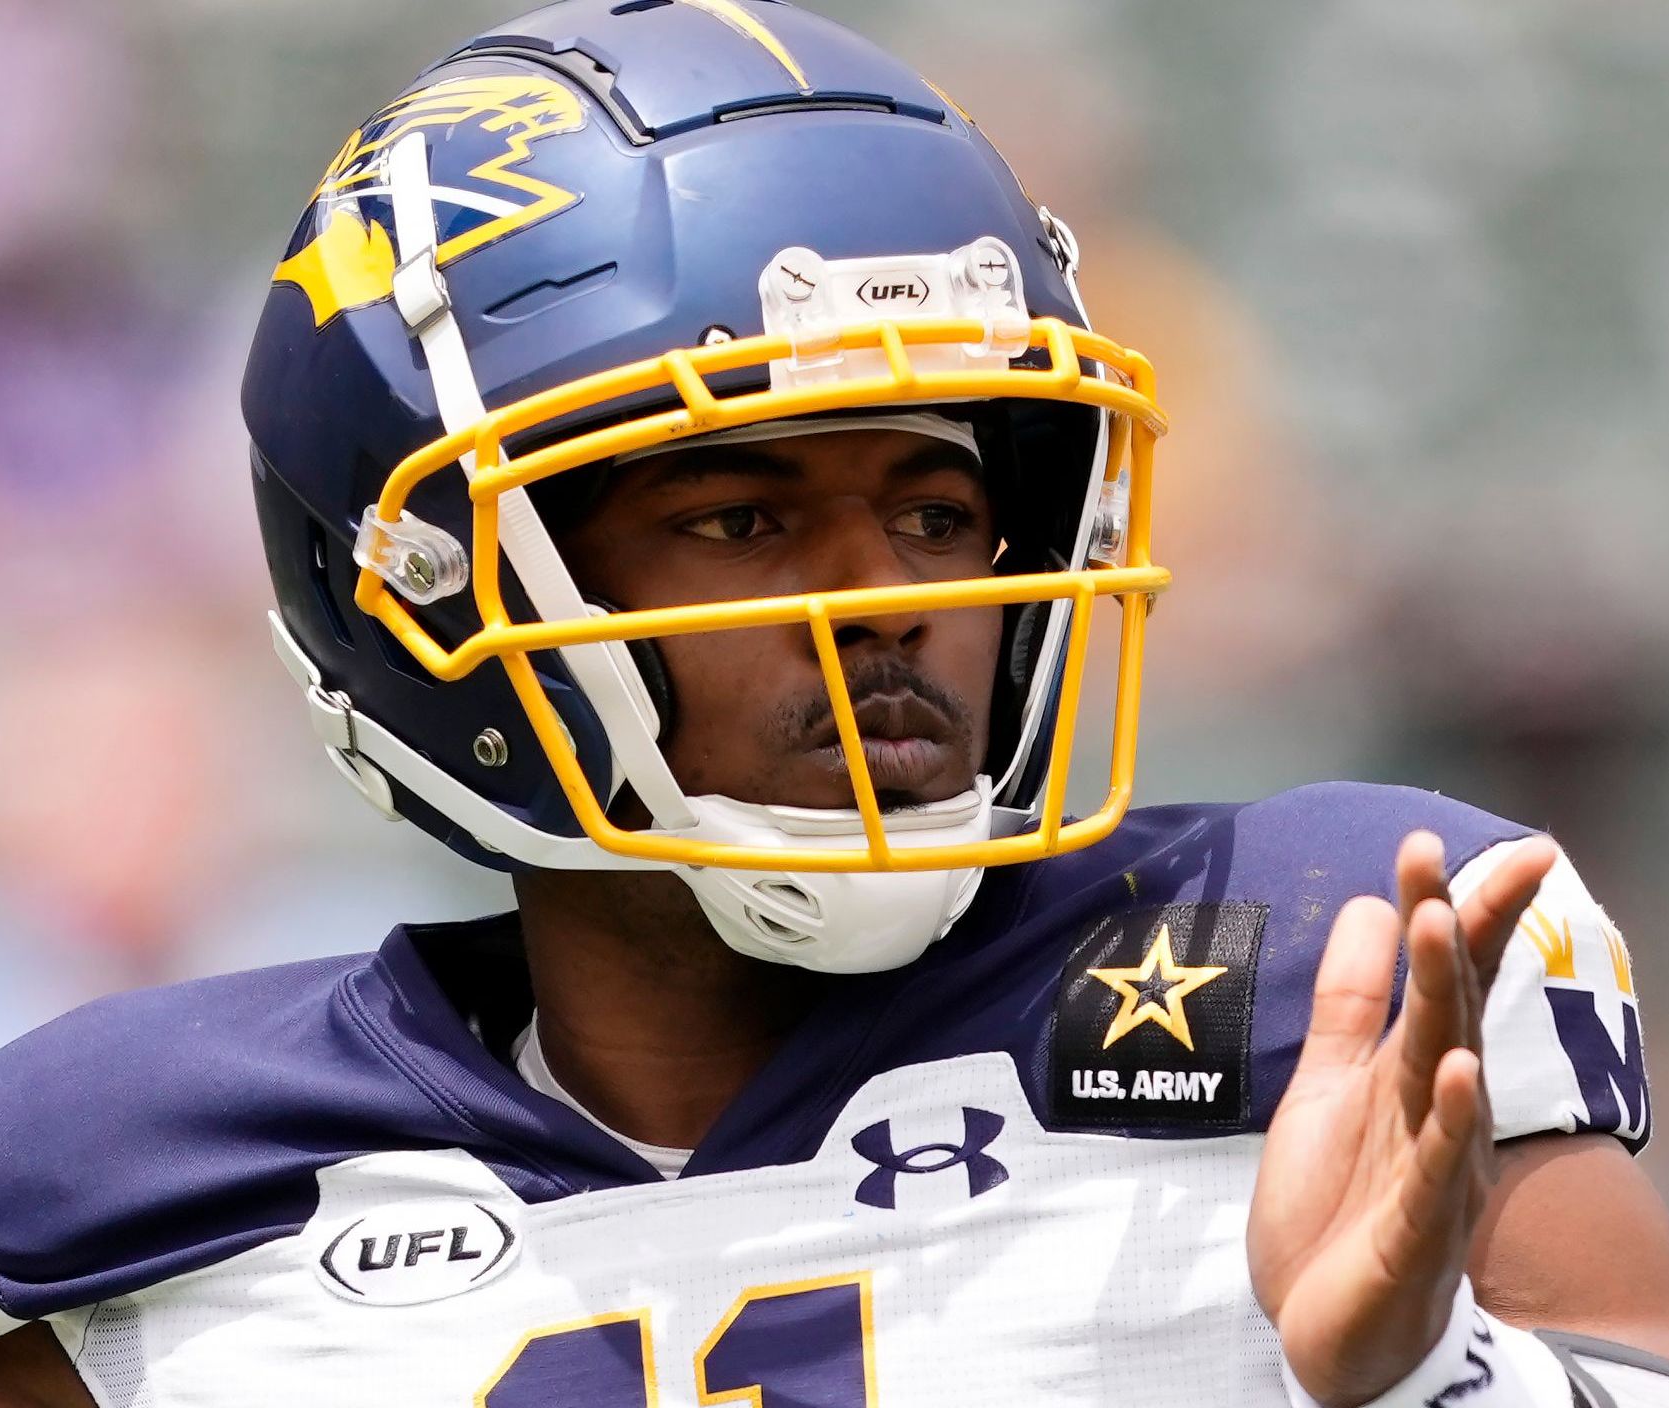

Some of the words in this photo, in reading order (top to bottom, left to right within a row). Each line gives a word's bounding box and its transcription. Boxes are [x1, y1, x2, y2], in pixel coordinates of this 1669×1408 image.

[871, 284, 920, 300] UFL
[1071, 1069, 1127, 1100] U.S.
[1131, 1071, 1223, 1103] ARMY
[358, 1226, 482, 1272] UFL
